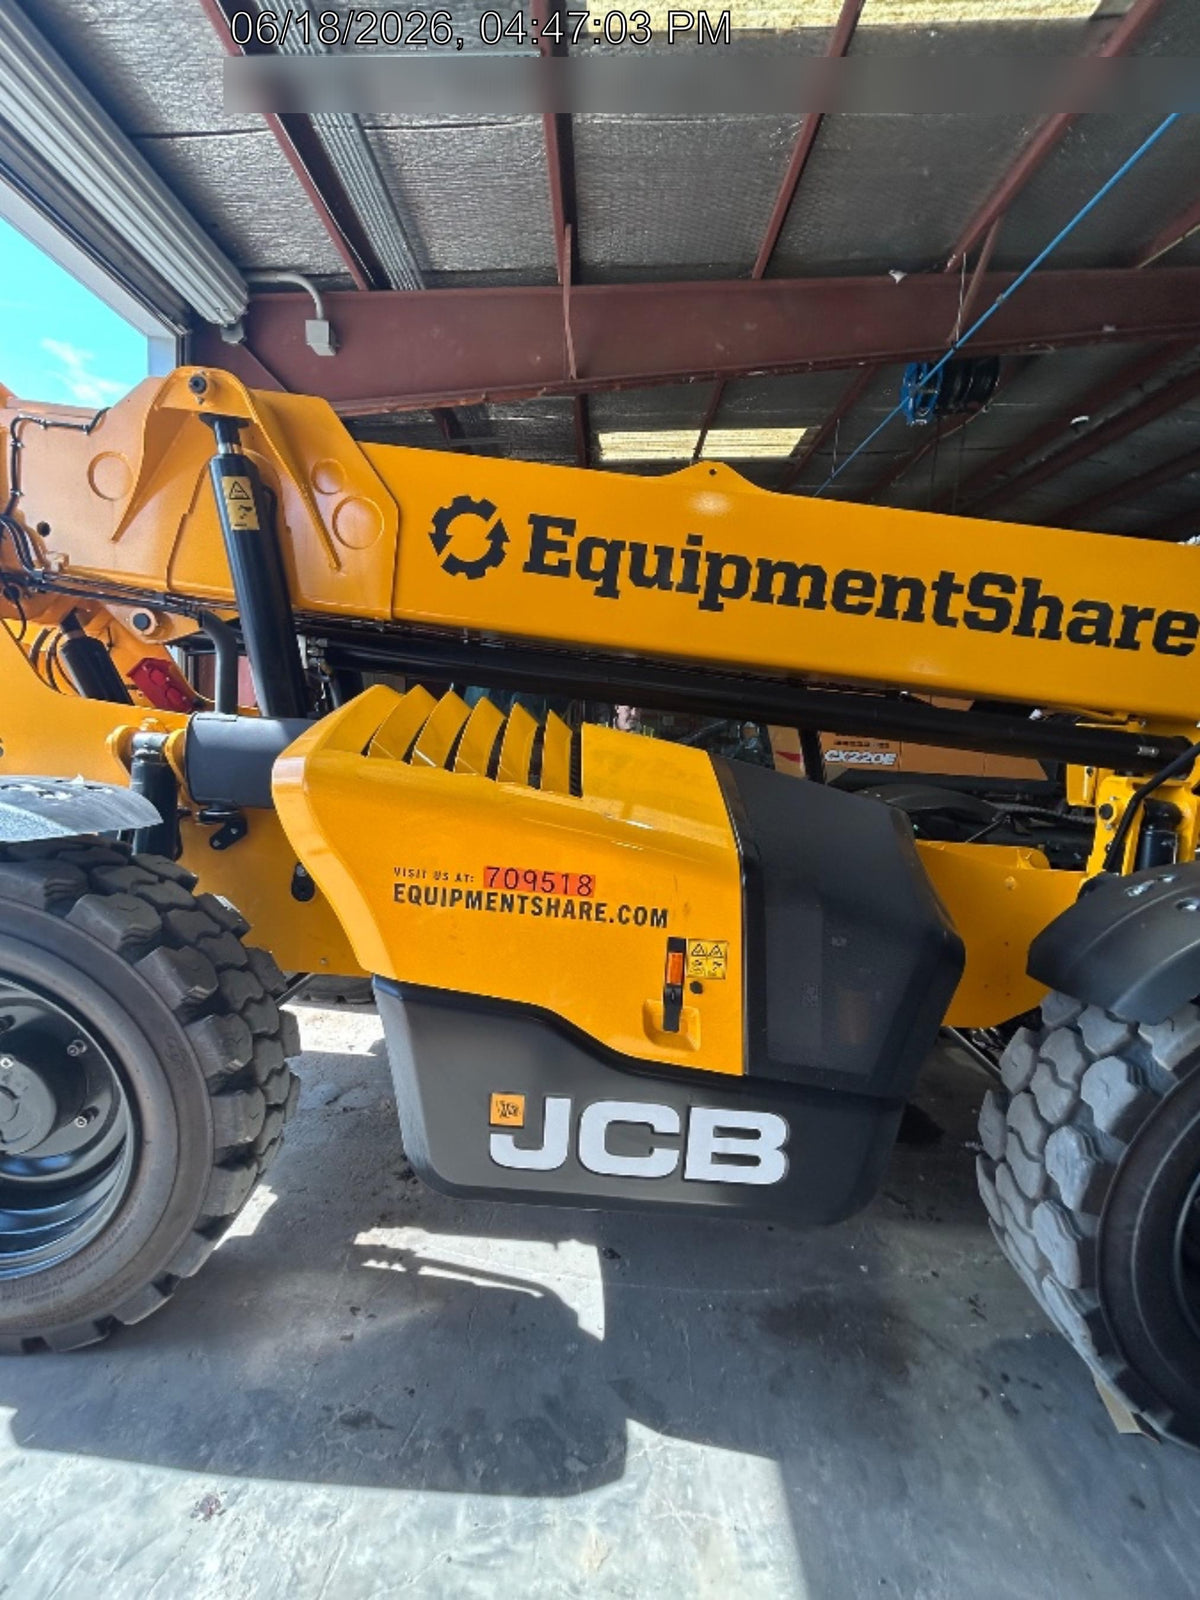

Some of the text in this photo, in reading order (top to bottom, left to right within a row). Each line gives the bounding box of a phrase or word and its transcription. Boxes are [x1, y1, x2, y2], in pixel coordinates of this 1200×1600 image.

[523, 512, 1200, 656] EquipmentShare
[394, 867, 475, 883] VISIT US AT:
[487, 867, 592, 897] 709518
[393, 884, 669, 929] EQUIPMENTSHARE.COM
[490, 1096, 789, 1184] JCB
